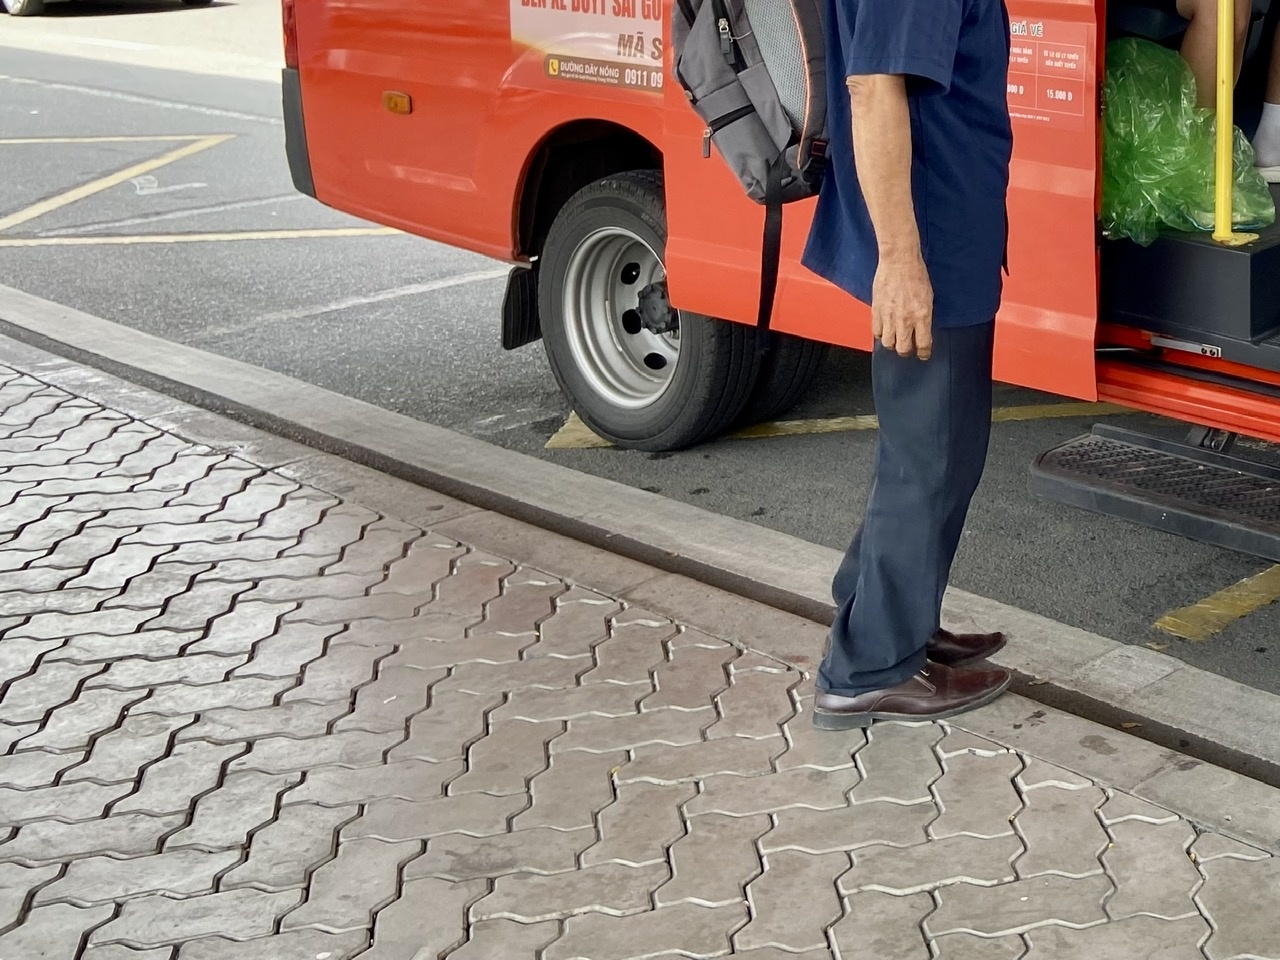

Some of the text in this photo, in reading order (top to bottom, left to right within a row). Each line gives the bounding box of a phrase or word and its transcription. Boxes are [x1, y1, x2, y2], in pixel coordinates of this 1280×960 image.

[617, 31, 645, 58] MÃ
[560, 61, 584, 74] ĐƯỜNG
[585, 64, 598, 75] DÂY
[599, 66, 620, 78] NÓNG
[625, 68, 647, 86] 0911
[1046, 89, 1067, 100] 15.000
